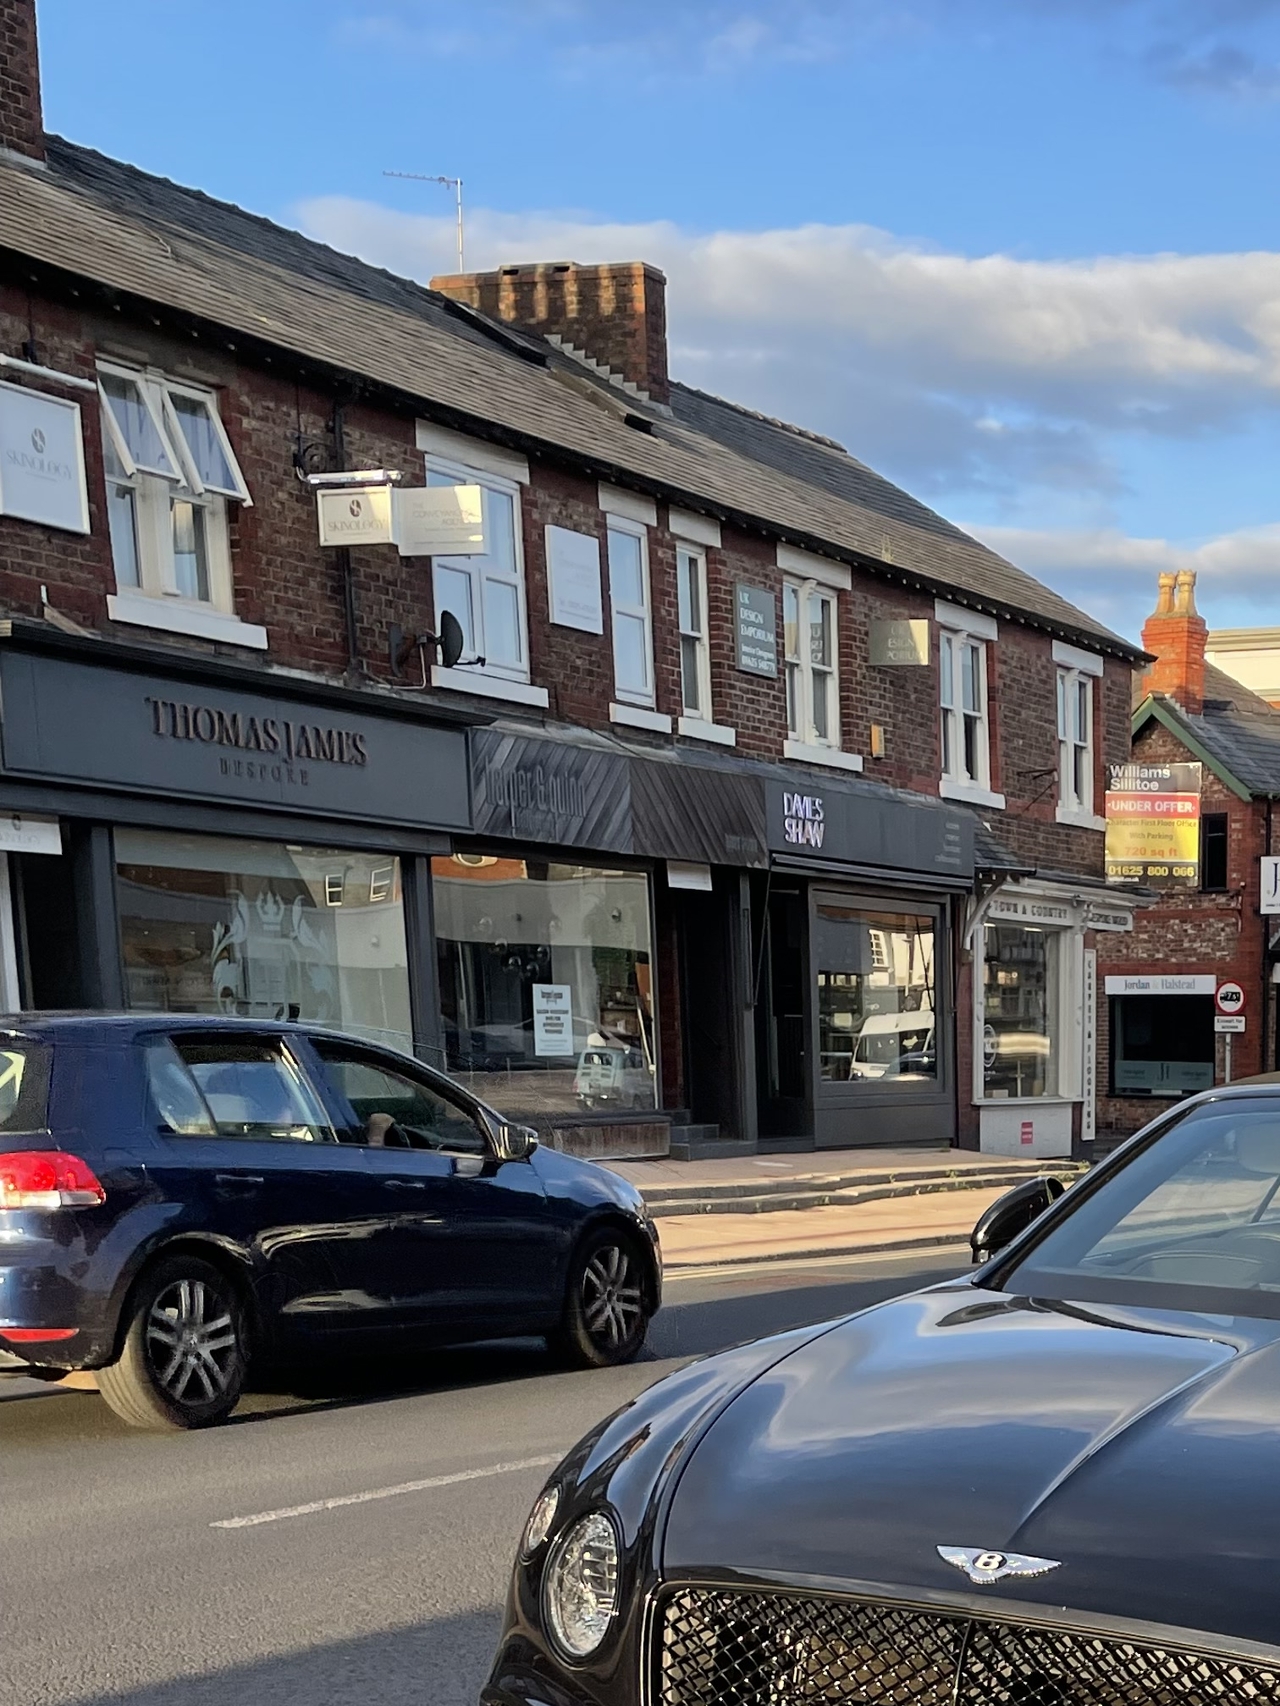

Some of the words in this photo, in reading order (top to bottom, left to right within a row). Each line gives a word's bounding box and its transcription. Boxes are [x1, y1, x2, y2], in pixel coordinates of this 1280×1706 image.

[328, 519, 384, 532] SKINOLOGY
[740, 607, 763, 624] DESIGN
[740, 624, 775, 643] EMPORIUM
[144, 697, 281, 752] THOMAS
[281, 720, 369, 767] JAMES
[219, 757, 309, 787] BESPOKE
[1110, 765, 1171, 779] Williams
[1110, 778, 1159, 791] Sillitoe
[485, 755, 533, 838] harper
[549, 770, 587, 843] quinn
[783, 791, 824, 821] DAVIES
[1111, 800, 1152, 812] UNDER
[1154, 801, 1193, 813] OFFER
[1141, 819, 1156, 827] First
[1176, 820, 1197, 828] Office
[784, 817, 824, 849] SHAW
[1147, 833, 1174, 841] Parking
[1125, 846, 1147, 856] 720
[1150, 848, 1165, 858] sq
[1168, 847, 1178, 857] ft
[1108, 866, 1144, 876] 01625
[1147, 866, 1169, 877] 800
[1172, 867, 1195, 877] 066
[993, 900, 1018, 914] TOWN
[1031, 905, 1068, 919] COUNTRY
[1124, 978, 1150, 991] Jordan
[1161, 978, 1196, 990] Halstead
